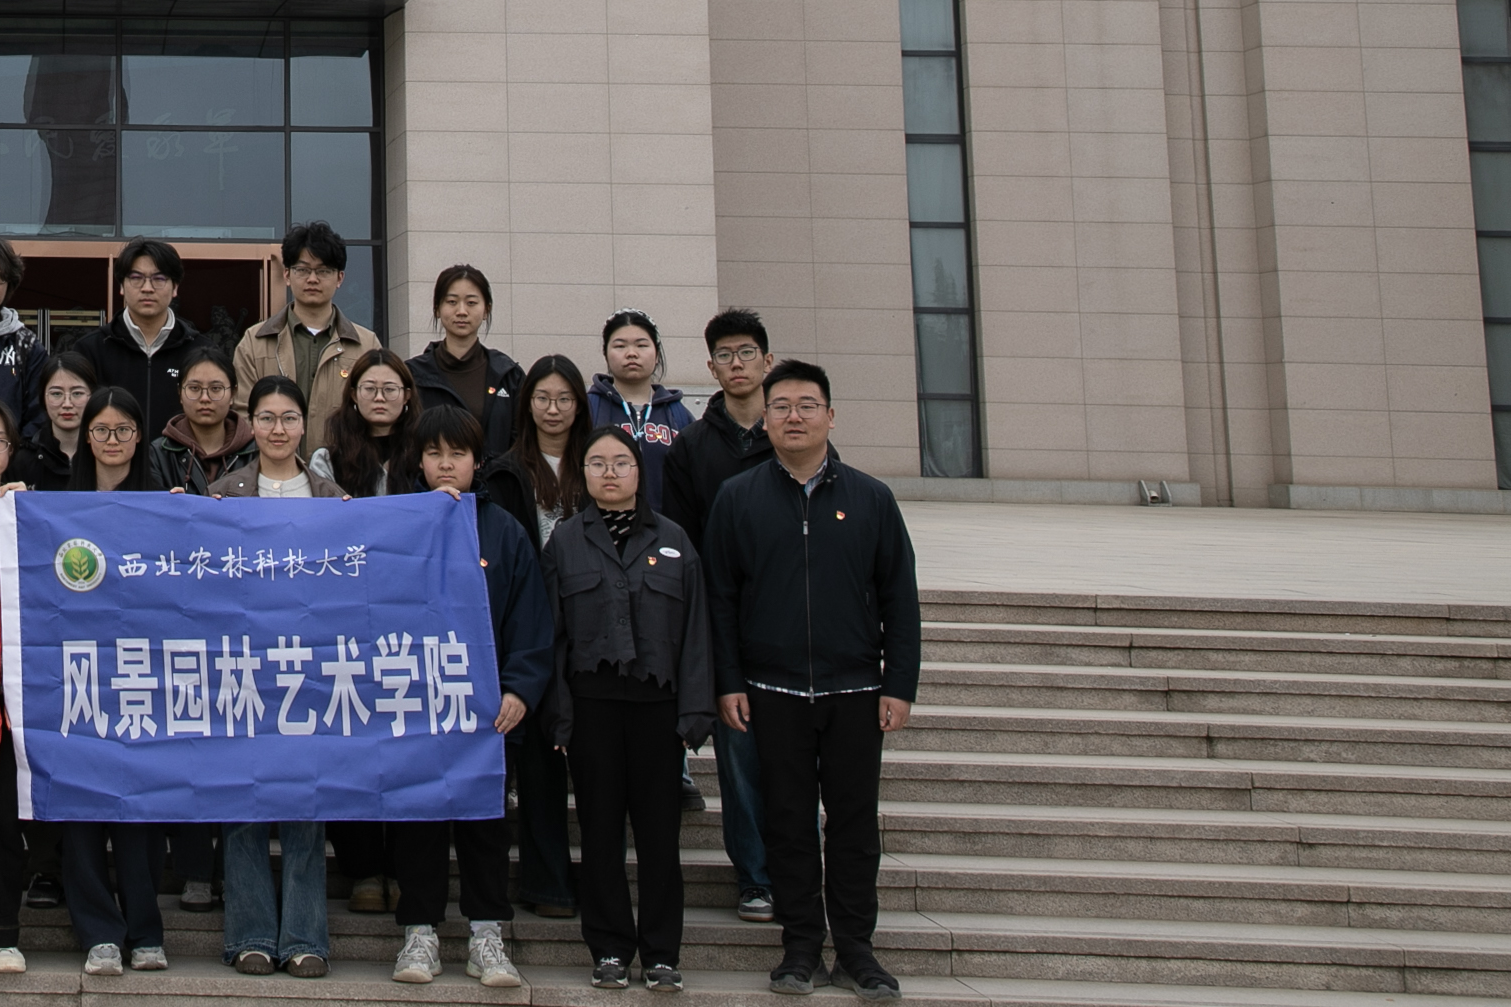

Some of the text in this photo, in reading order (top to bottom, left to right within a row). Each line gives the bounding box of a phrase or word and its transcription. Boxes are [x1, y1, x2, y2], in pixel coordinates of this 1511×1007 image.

[118, 544, 367, 581] 西北农林科技大学
[60, 630, 477, 740] 风景园林艺术学院
